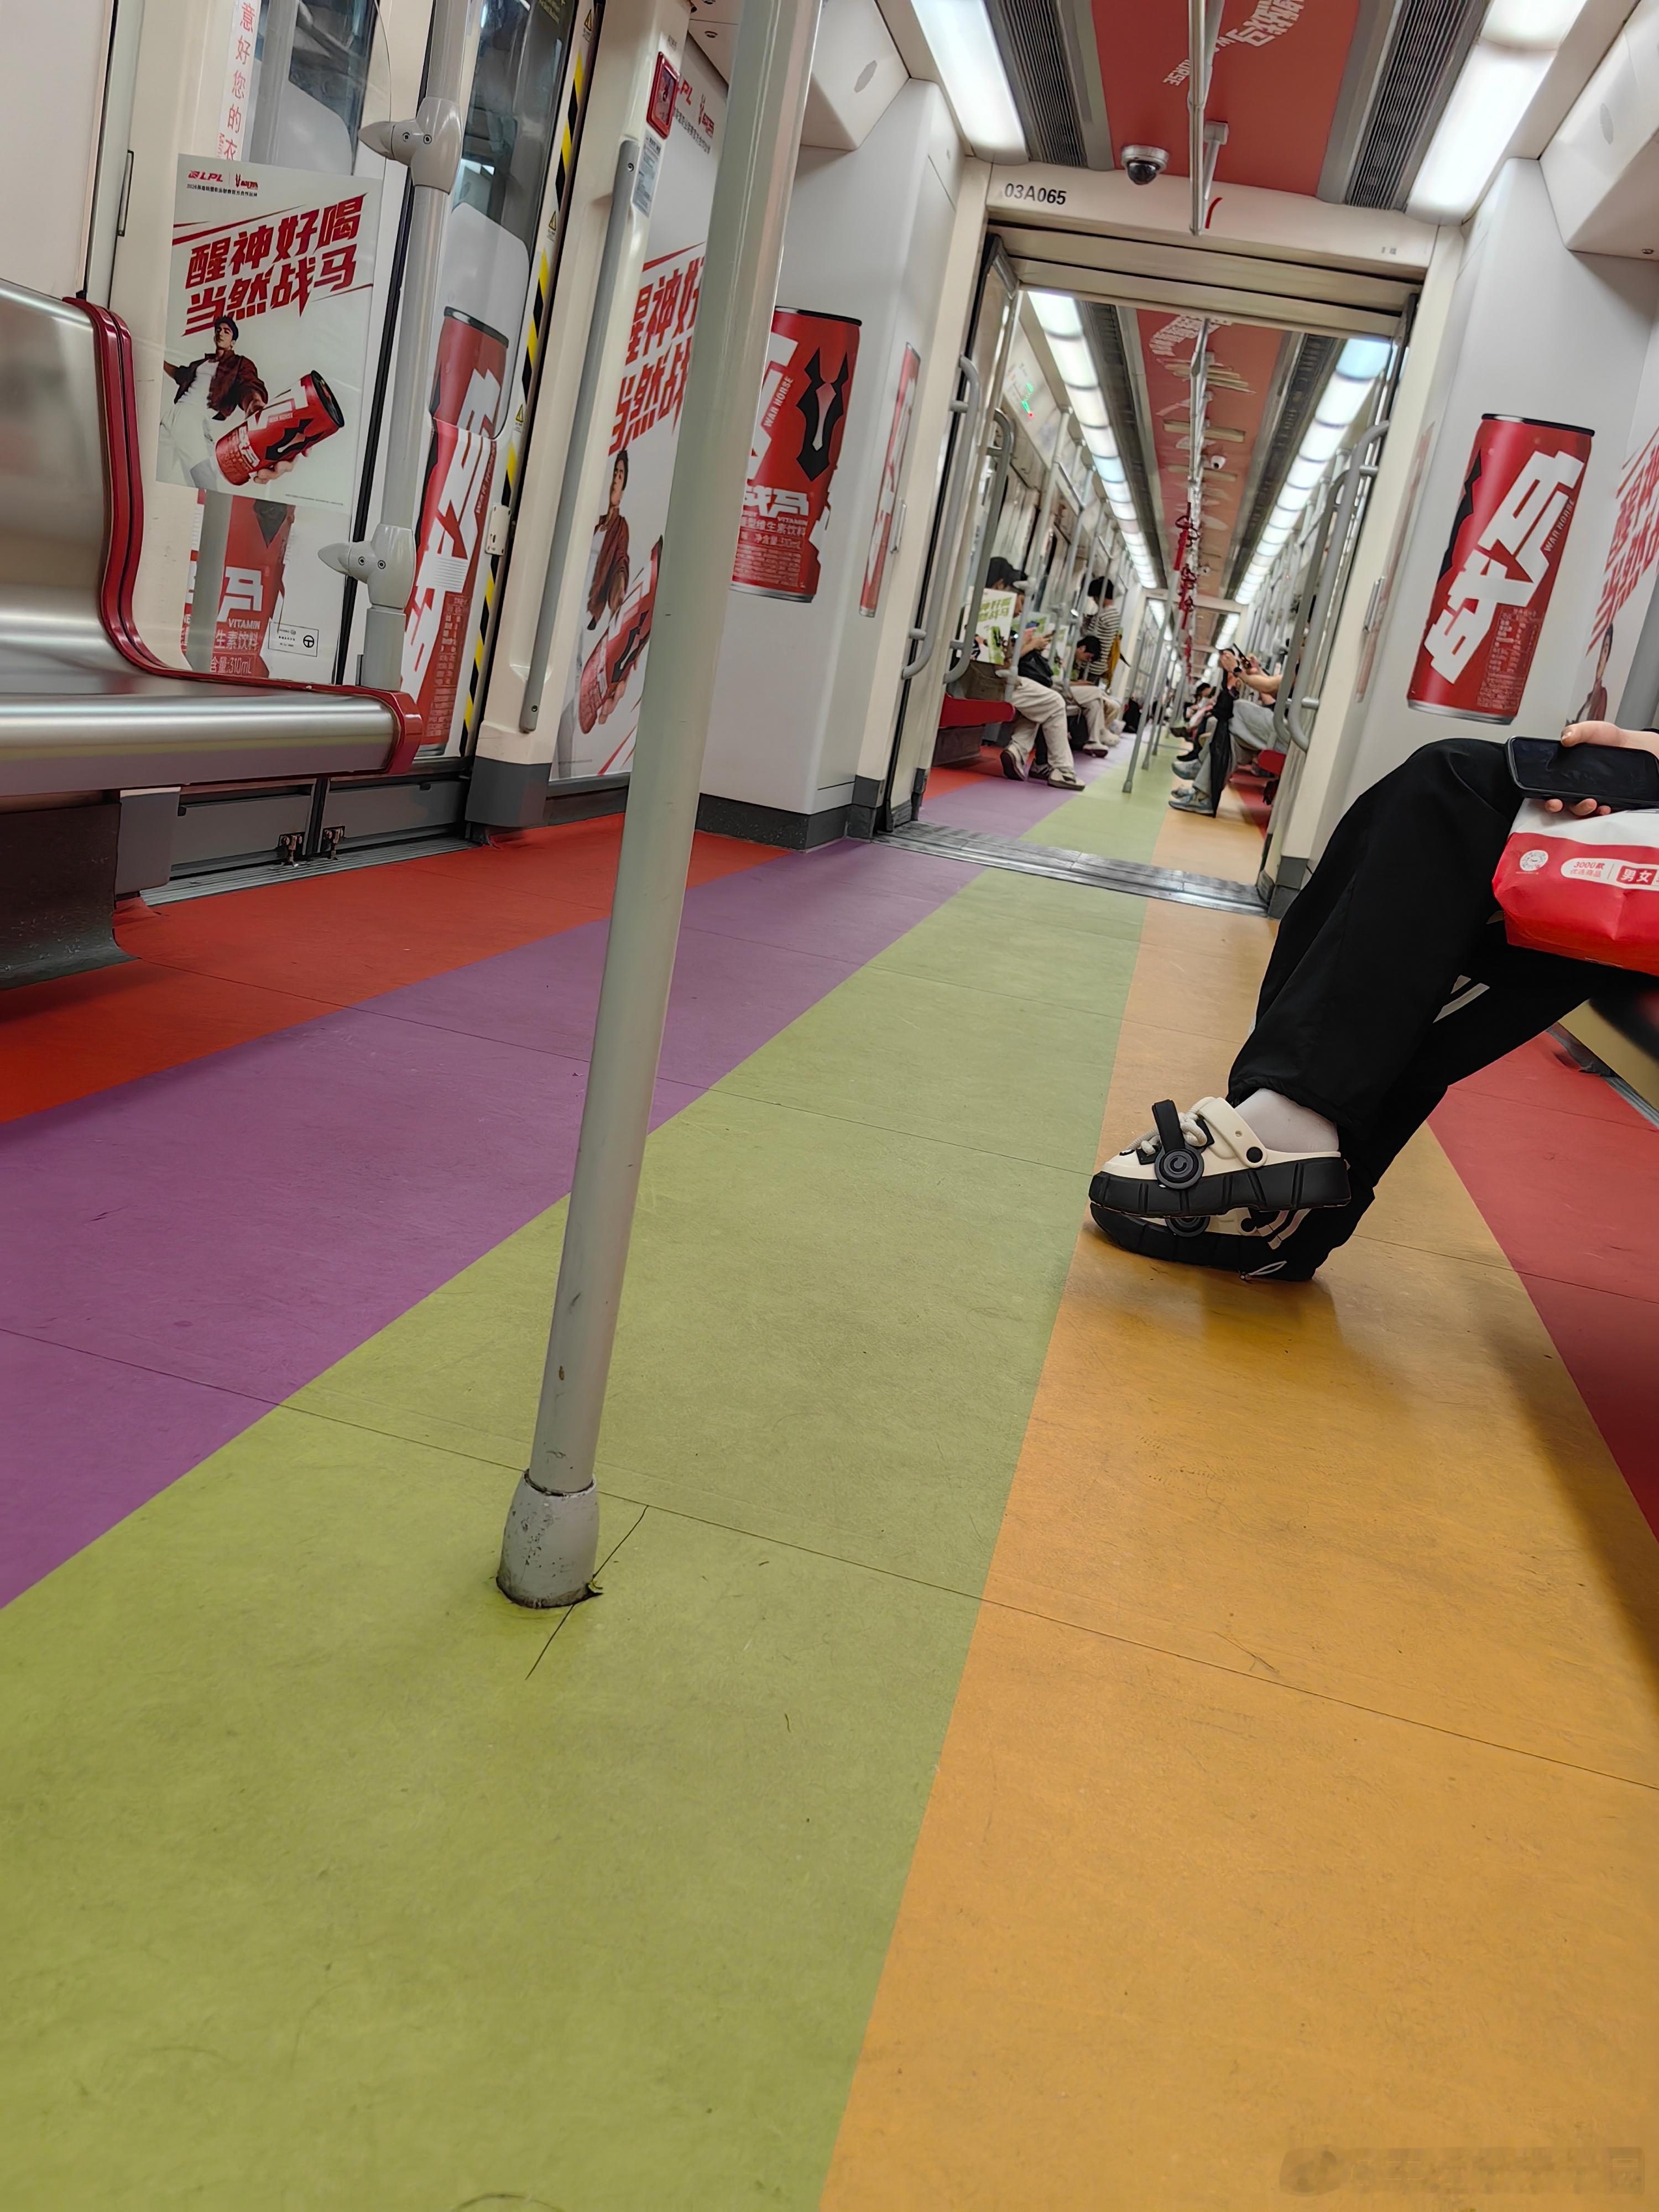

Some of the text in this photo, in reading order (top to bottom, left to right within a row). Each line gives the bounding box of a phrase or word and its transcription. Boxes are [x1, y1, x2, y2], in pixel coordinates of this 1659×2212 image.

[678, 79, 693, 106] PL
[200, 171, 223, 182] LPL
[1005, 183, 1067, 205] 03A065
[185, 193, 367, 290] 醒神好喝
[181, 243, 358, 337] 当然战马
[763, 376, 794, 427] WAR HORSE
[1543, 529, 1559, 552] WAR
[228, 618, 260, 630] VITAMIN
[213, 629, 259, 650] 生素饮料
[1574, 862, 1605, 870] 3000款
[1620, 868, 1653, 883] 男女
